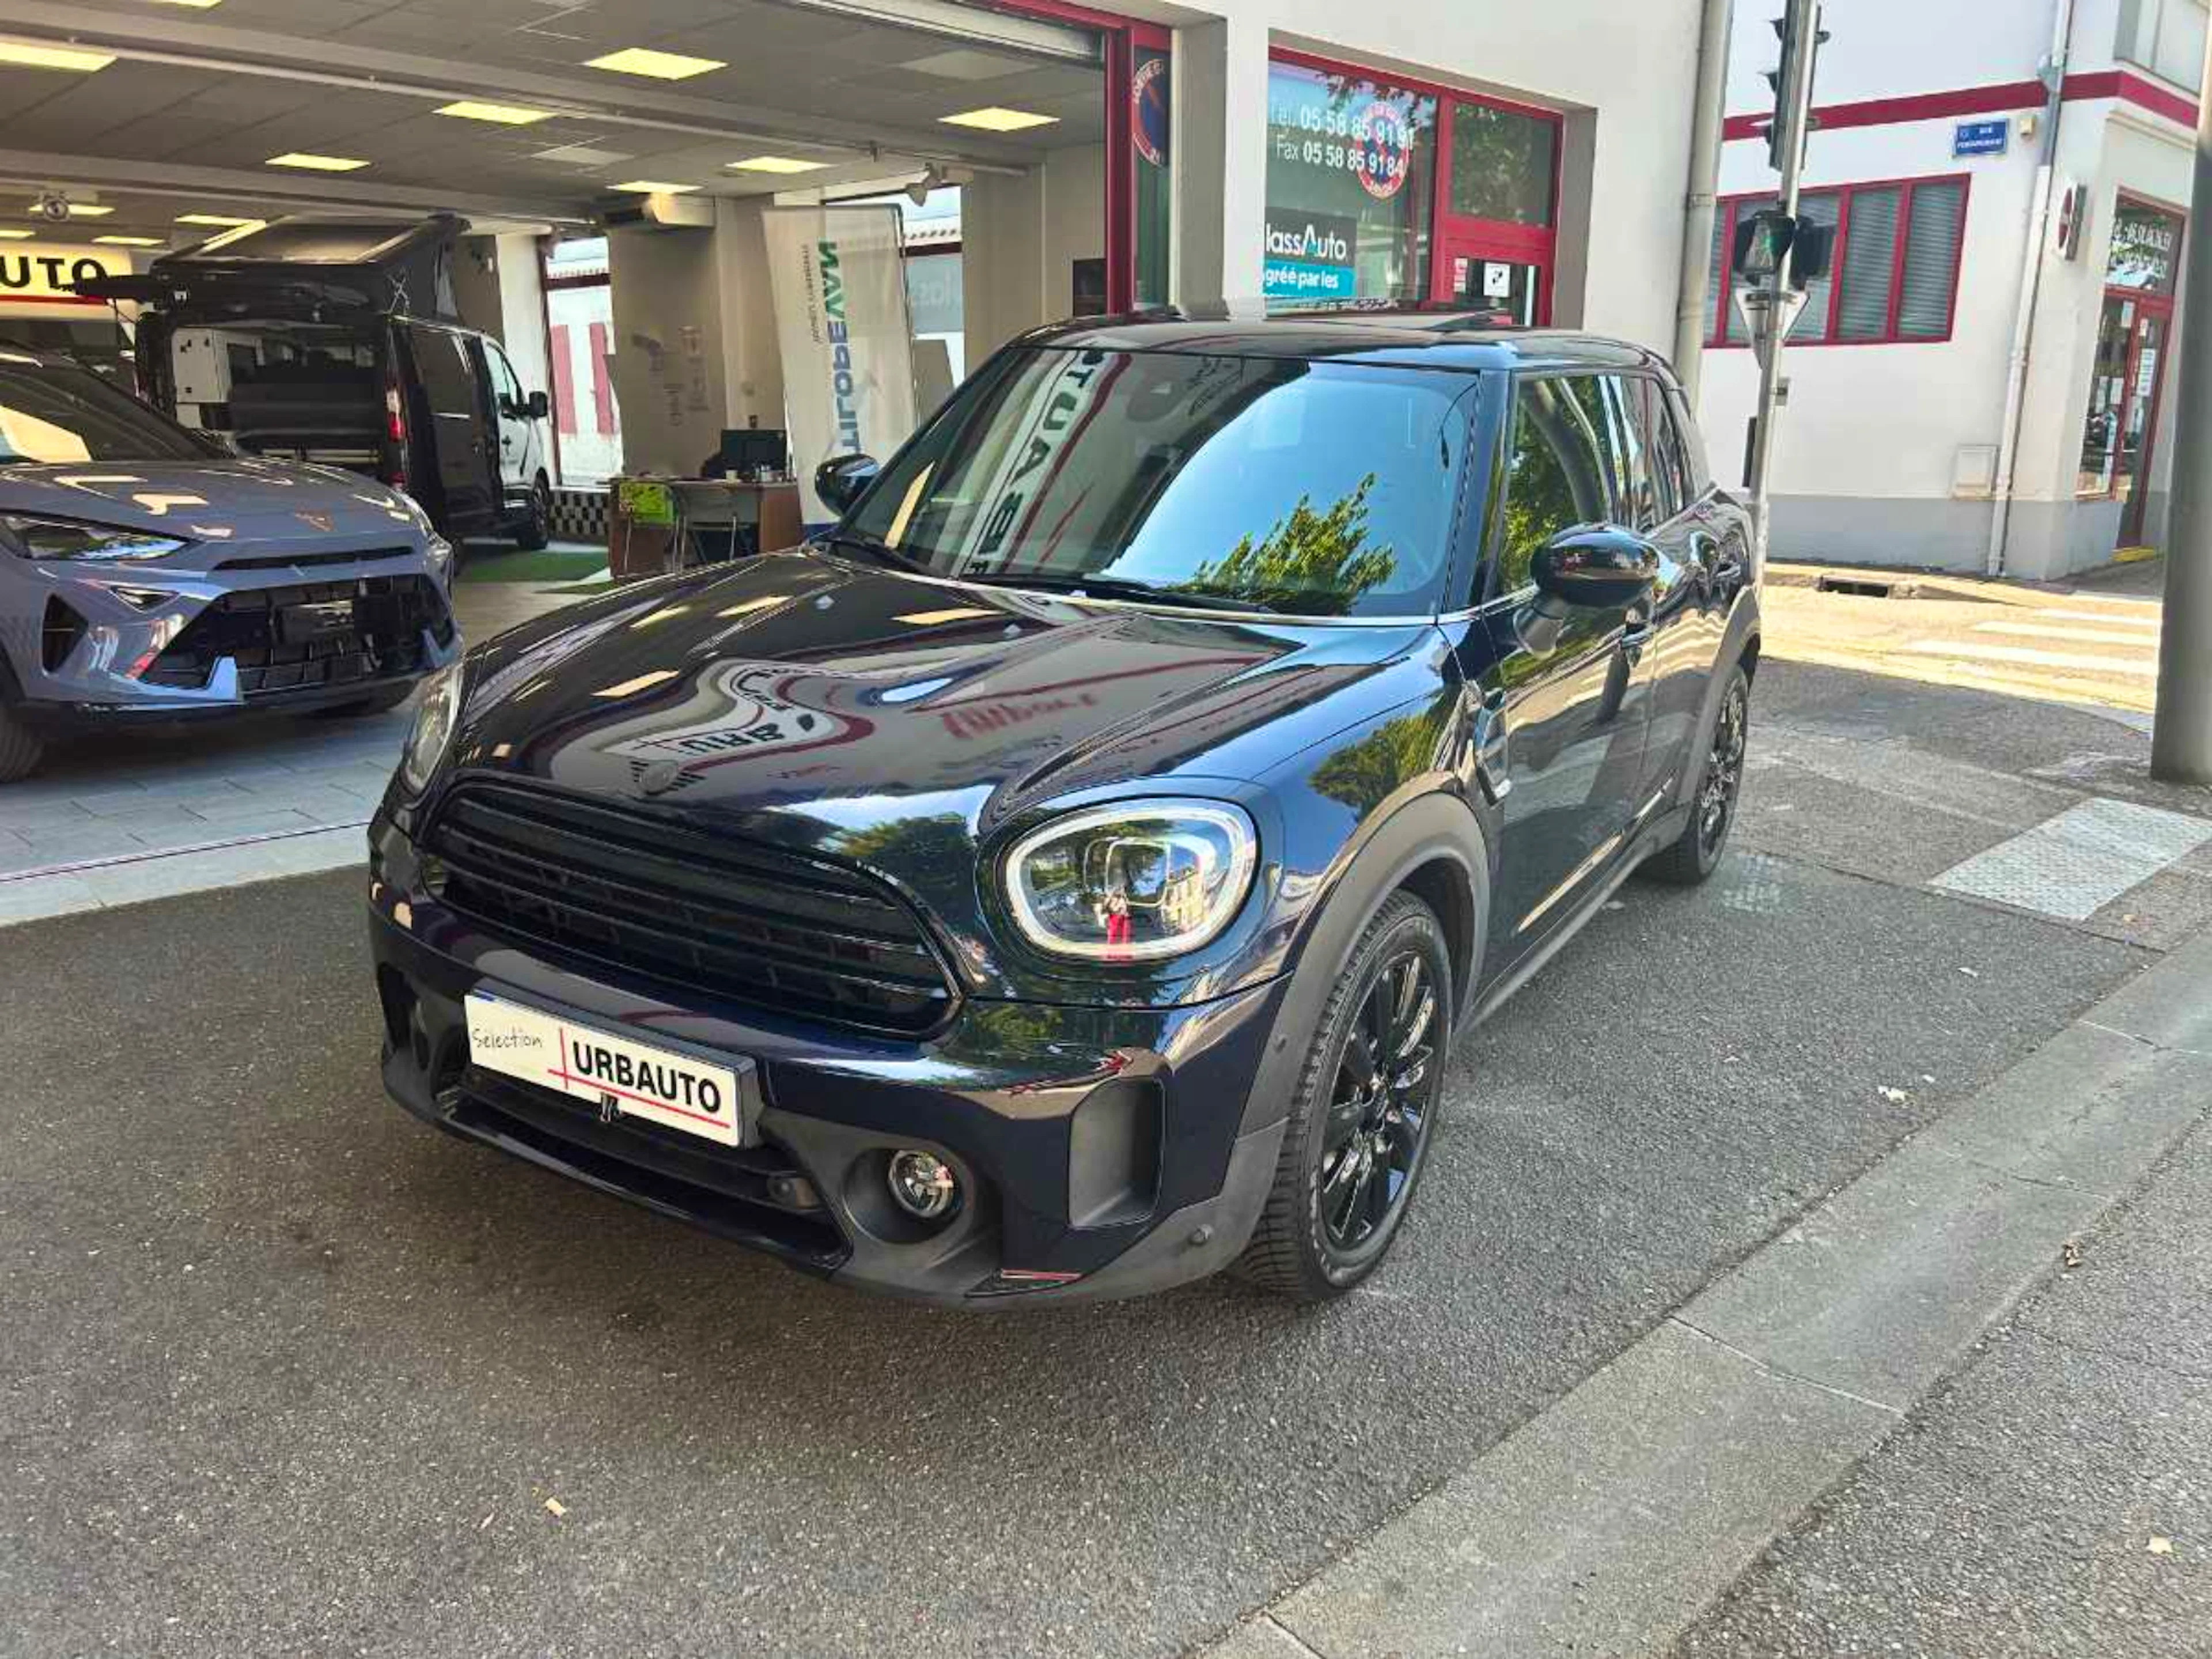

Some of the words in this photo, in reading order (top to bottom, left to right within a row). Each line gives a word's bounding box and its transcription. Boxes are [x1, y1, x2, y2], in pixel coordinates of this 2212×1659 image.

[1301, 104, 1321, 132] 05
[1326, 111, 1347, 137] 58
[1376, 120, 1393, 147] 91
[1277, 134, 1298, 160] Fax
[1303, 140, 1323, 164] 05
[1326, 144, 1344, 168] 58
[1347, 149, 1365, 172] 85
[1369, 152, 1384, 175] 91
[1387, 156, 1406, 179] 84
[1297, 272, 1320, 290] par
[1321, 270, 1339, 289] les
[573, 1040, 721, 1113] URBAUTO
